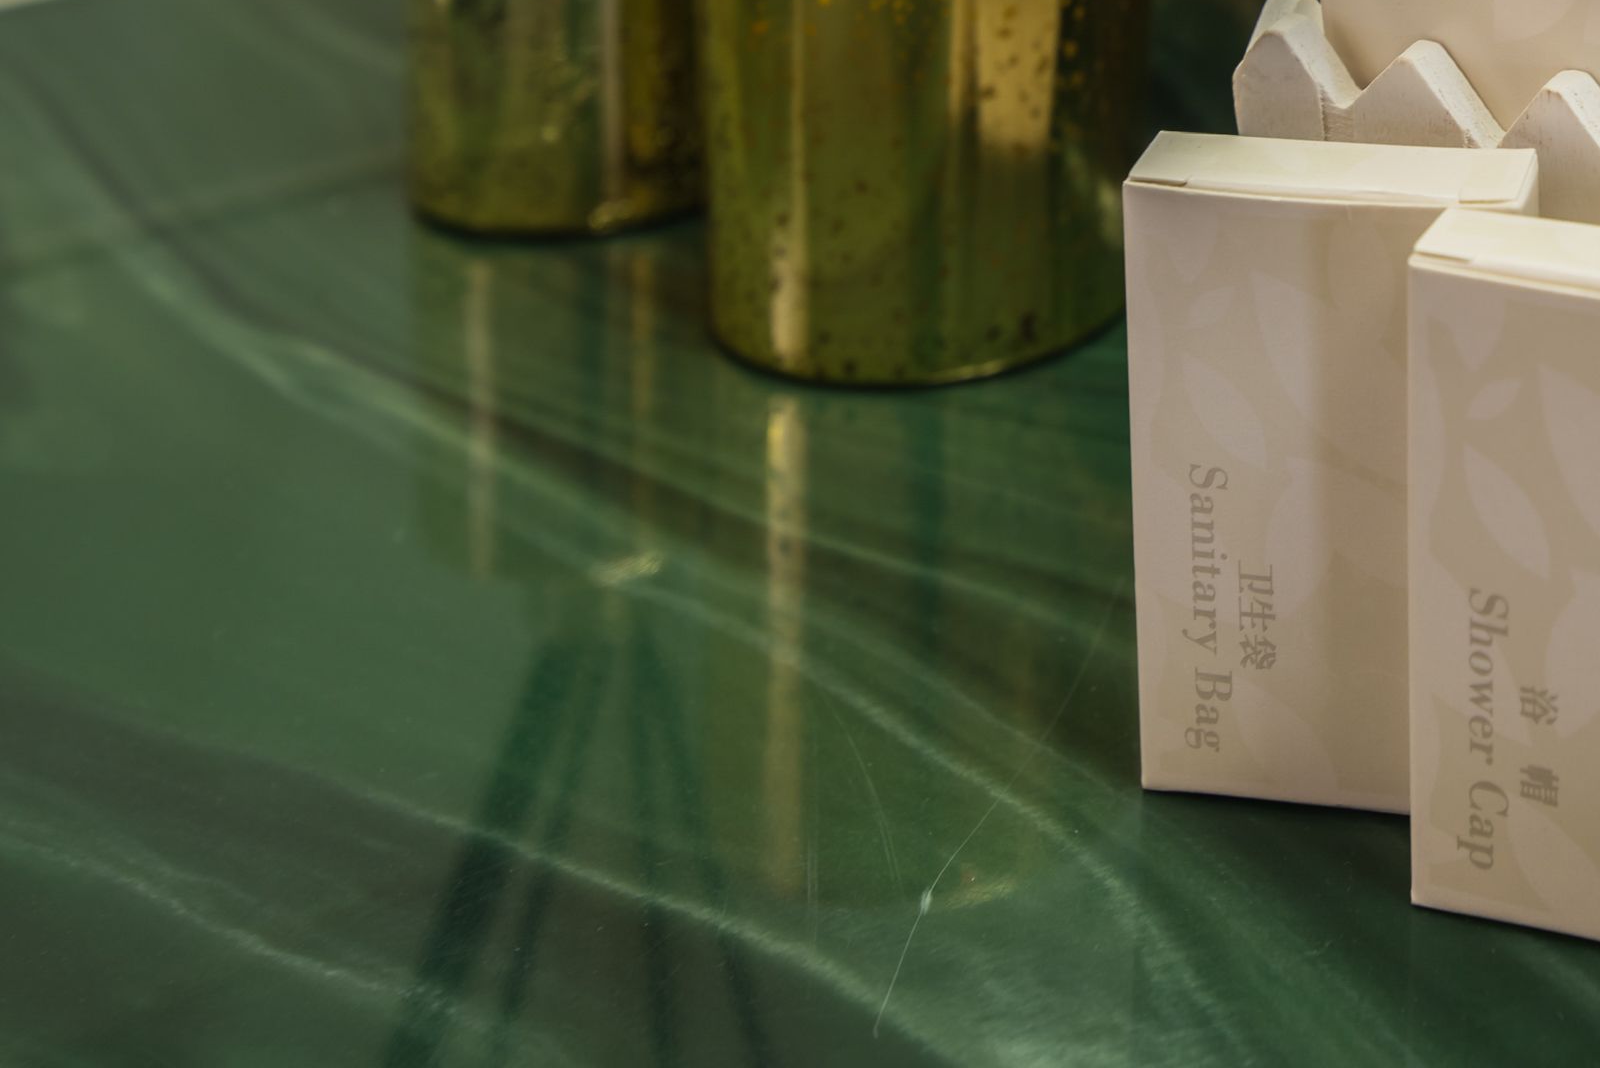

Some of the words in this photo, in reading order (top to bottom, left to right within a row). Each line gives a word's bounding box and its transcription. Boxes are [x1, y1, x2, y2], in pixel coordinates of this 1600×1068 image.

[1181, 463, 1228, 655] Sanitary
[1238, 559, 1277, 670] 卫生袋
[1184, 667, 1233, 752] Bag
[1468, 587, 1510, 766] Shower
[1456, 780, 1510, 871] Cap
